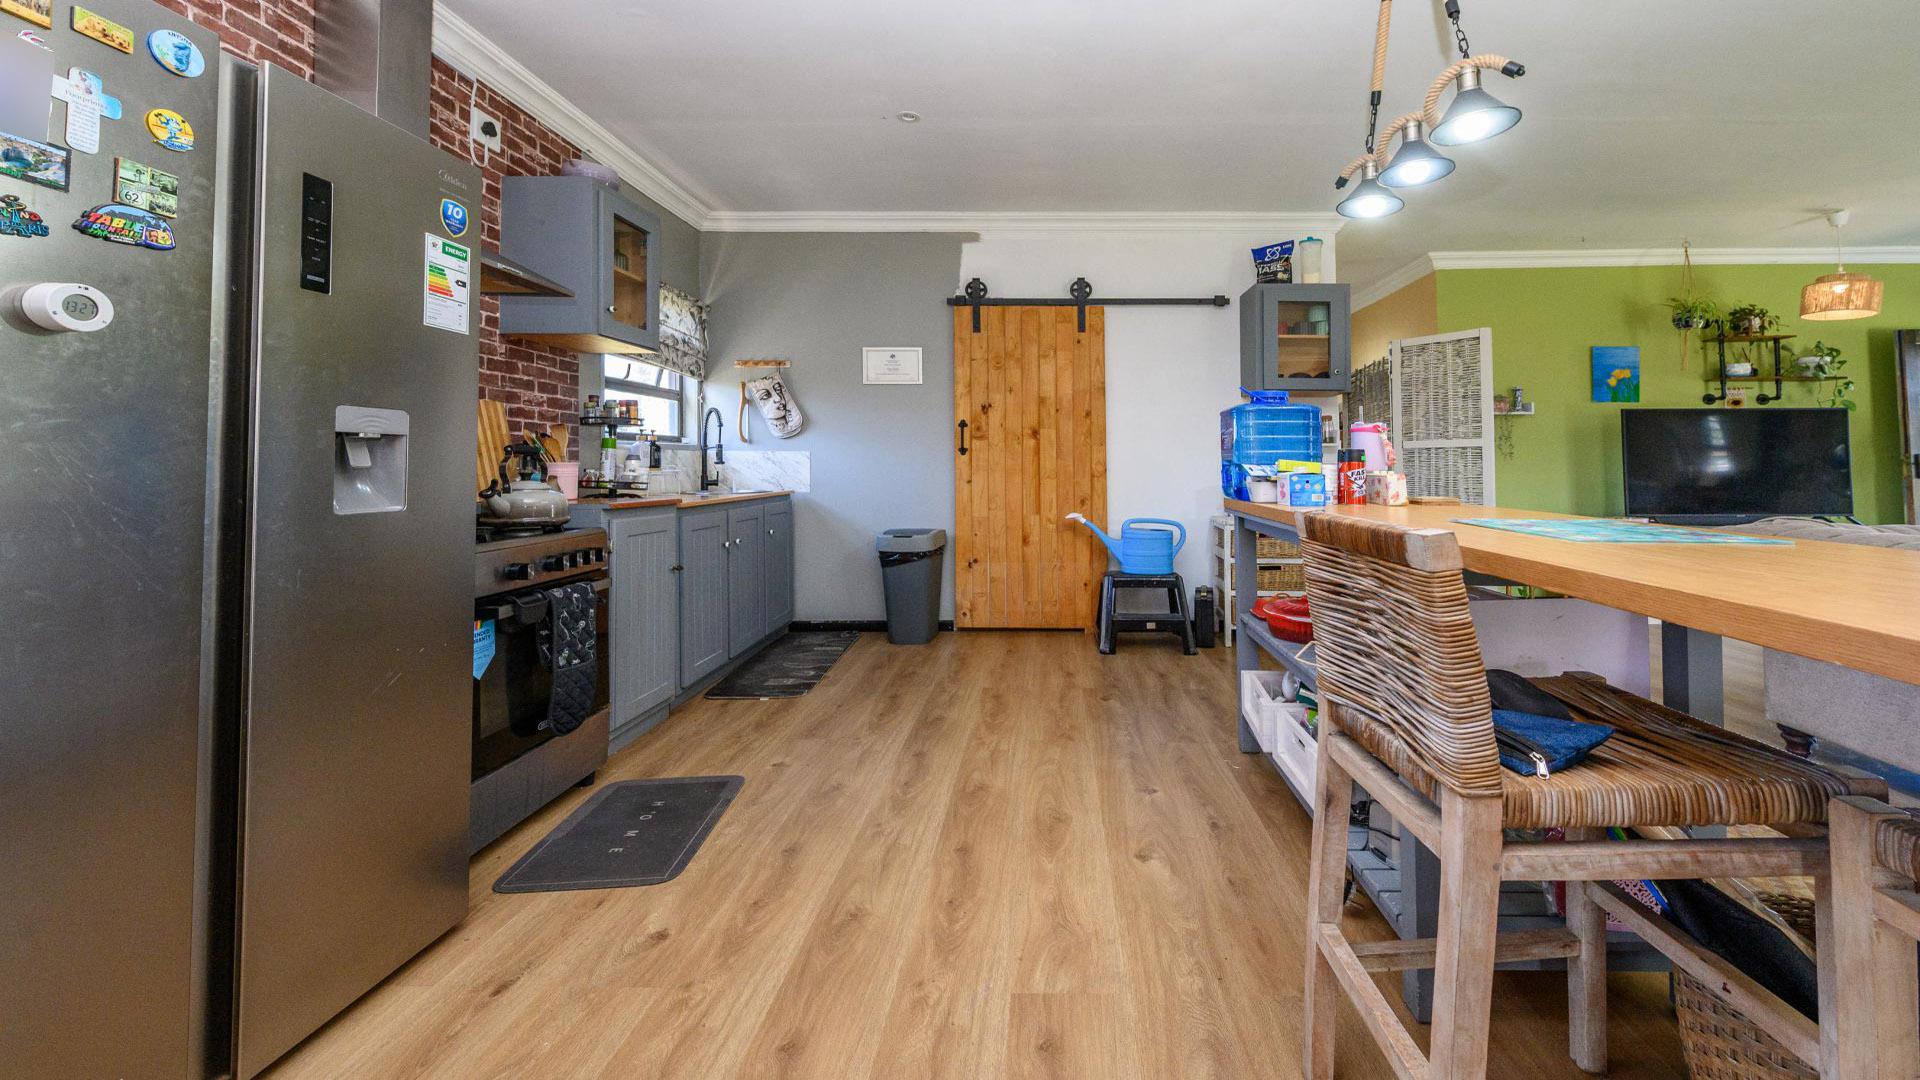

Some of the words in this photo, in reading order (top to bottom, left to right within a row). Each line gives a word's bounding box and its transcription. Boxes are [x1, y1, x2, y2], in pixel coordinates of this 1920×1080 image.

[125, 191, 139, 203] 62
[447, 204, 463, 219] 10
[88, 212, 145, 233] TABLE
[445, 245, 467, 259] ENERGY
[608, 800, 665, 854] HOME
